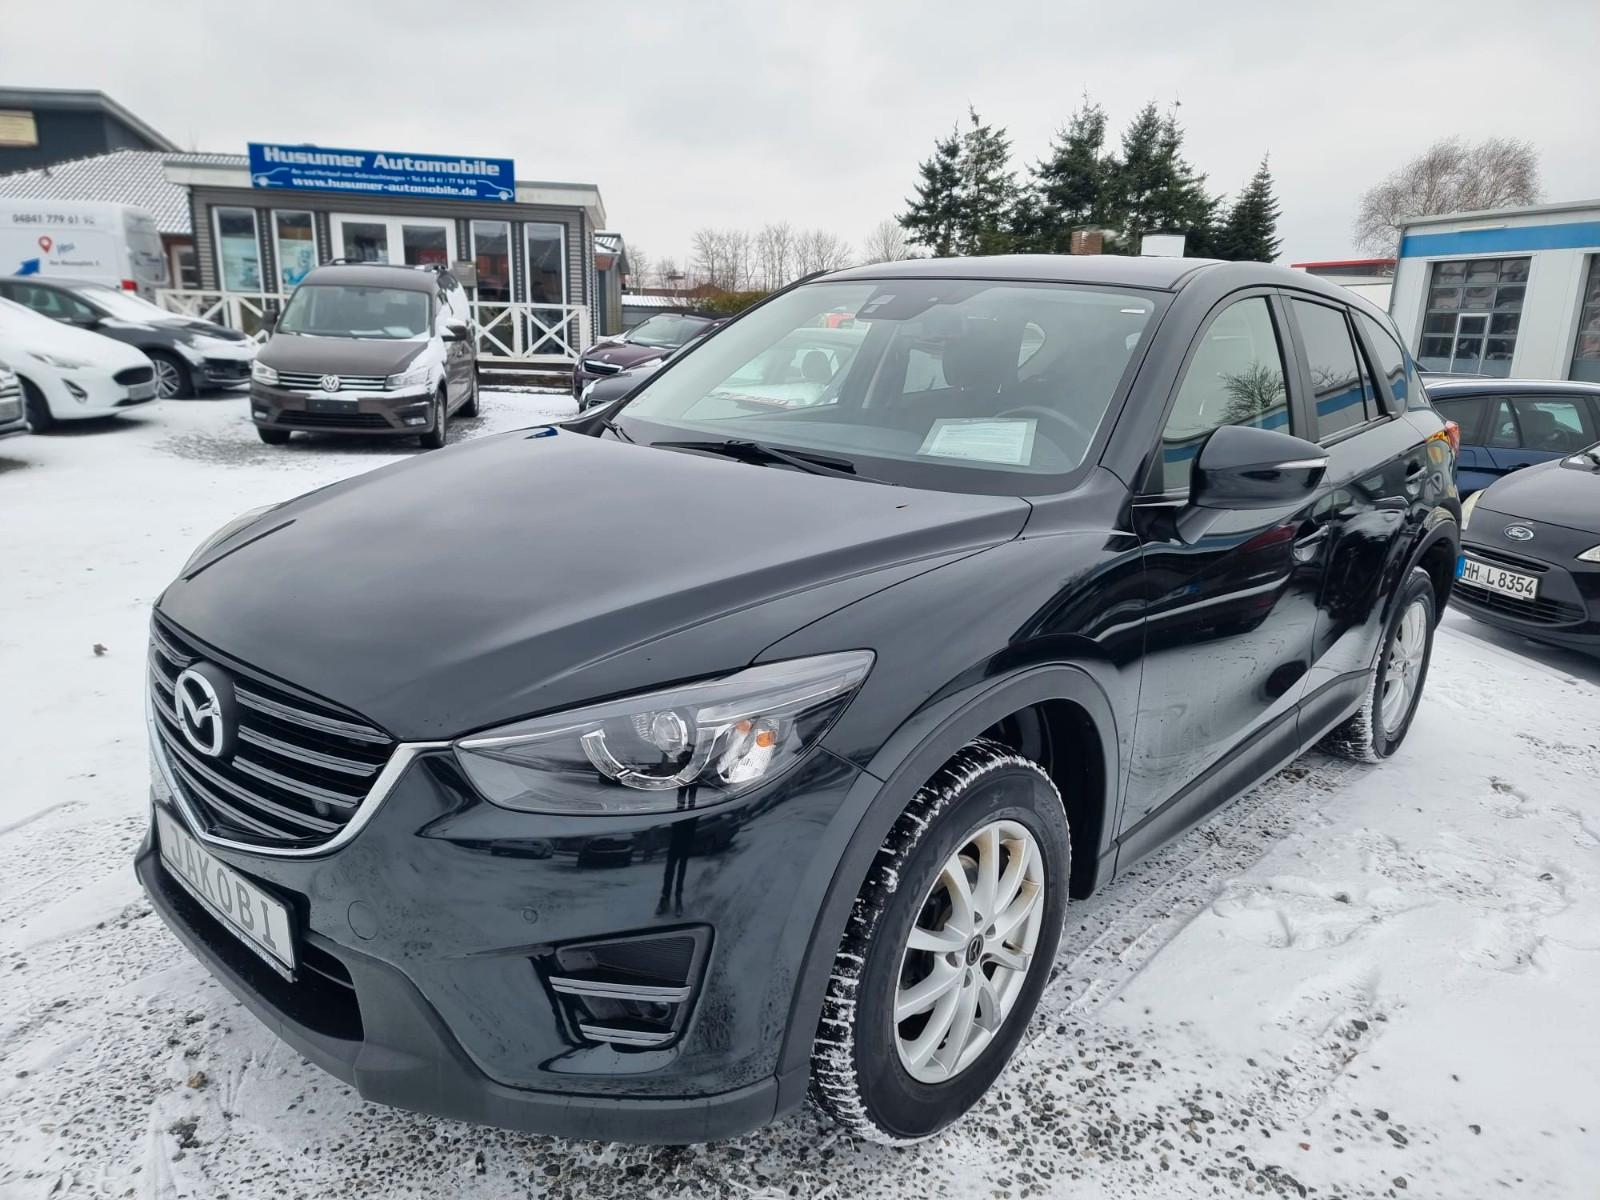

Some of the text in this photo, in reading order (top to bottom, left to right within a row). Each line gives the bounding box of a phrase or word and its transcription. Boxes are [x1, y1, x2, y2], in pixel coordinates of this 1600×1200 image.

[263, 146, 500, 176] Husumer Automobile
[291, 177, 478, 197] www.husumer-automobile.de
[1463, 561, 1480, 581] HH
[1486, 568, 1495, 586] L
[1498, 573, 1534, 596] 8354
[170, 823, 277, 951] JAKOBI
